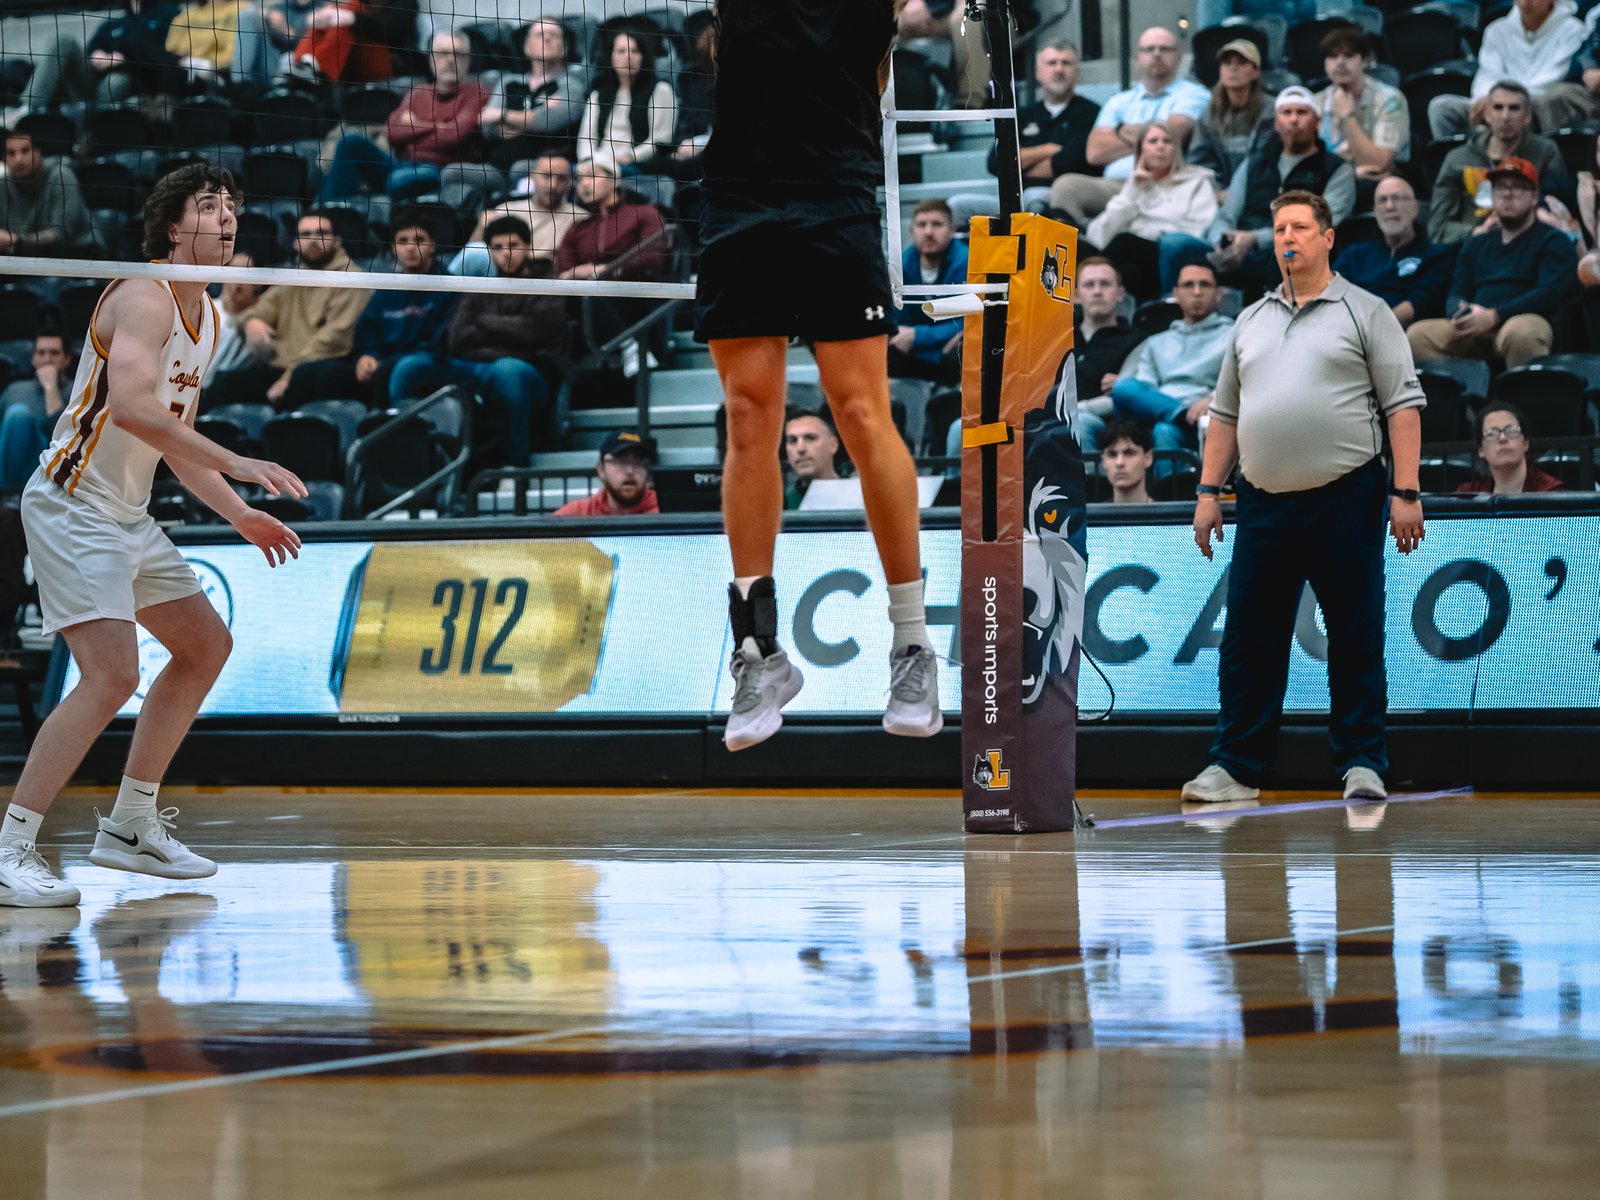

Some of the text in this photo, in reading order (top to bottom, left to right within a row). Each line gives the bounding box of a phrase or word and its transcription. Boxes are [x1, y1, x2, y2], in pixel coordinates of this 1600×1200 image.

[419, 577, 529, 676] 312
[982, 576, 997, 724] sports imports
